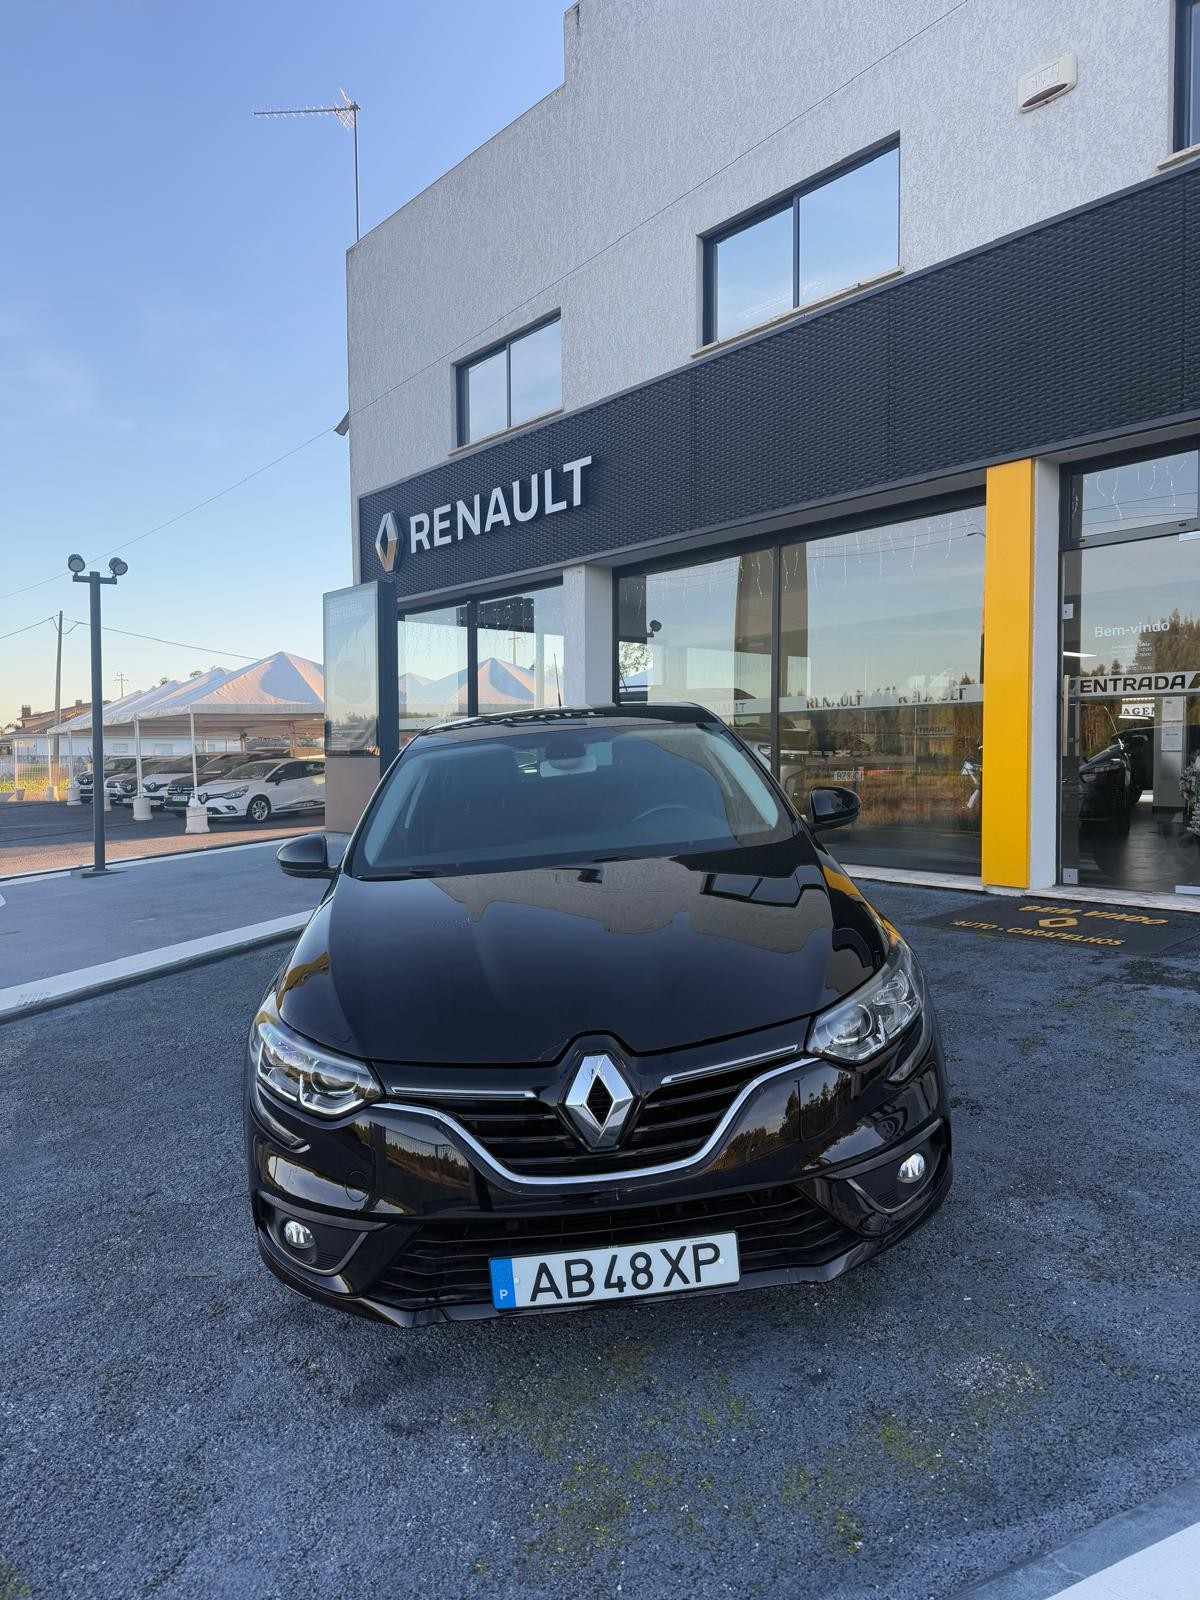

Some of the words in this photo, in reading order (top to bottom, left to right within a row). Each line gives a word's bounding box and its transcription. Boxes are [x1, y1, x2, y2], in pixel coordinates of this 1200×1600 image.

[410, 456, 592, 553] RENAULT
[1080, 674, 1186, 693] ENTRADA
[499, 1289, 509, 1300] P
